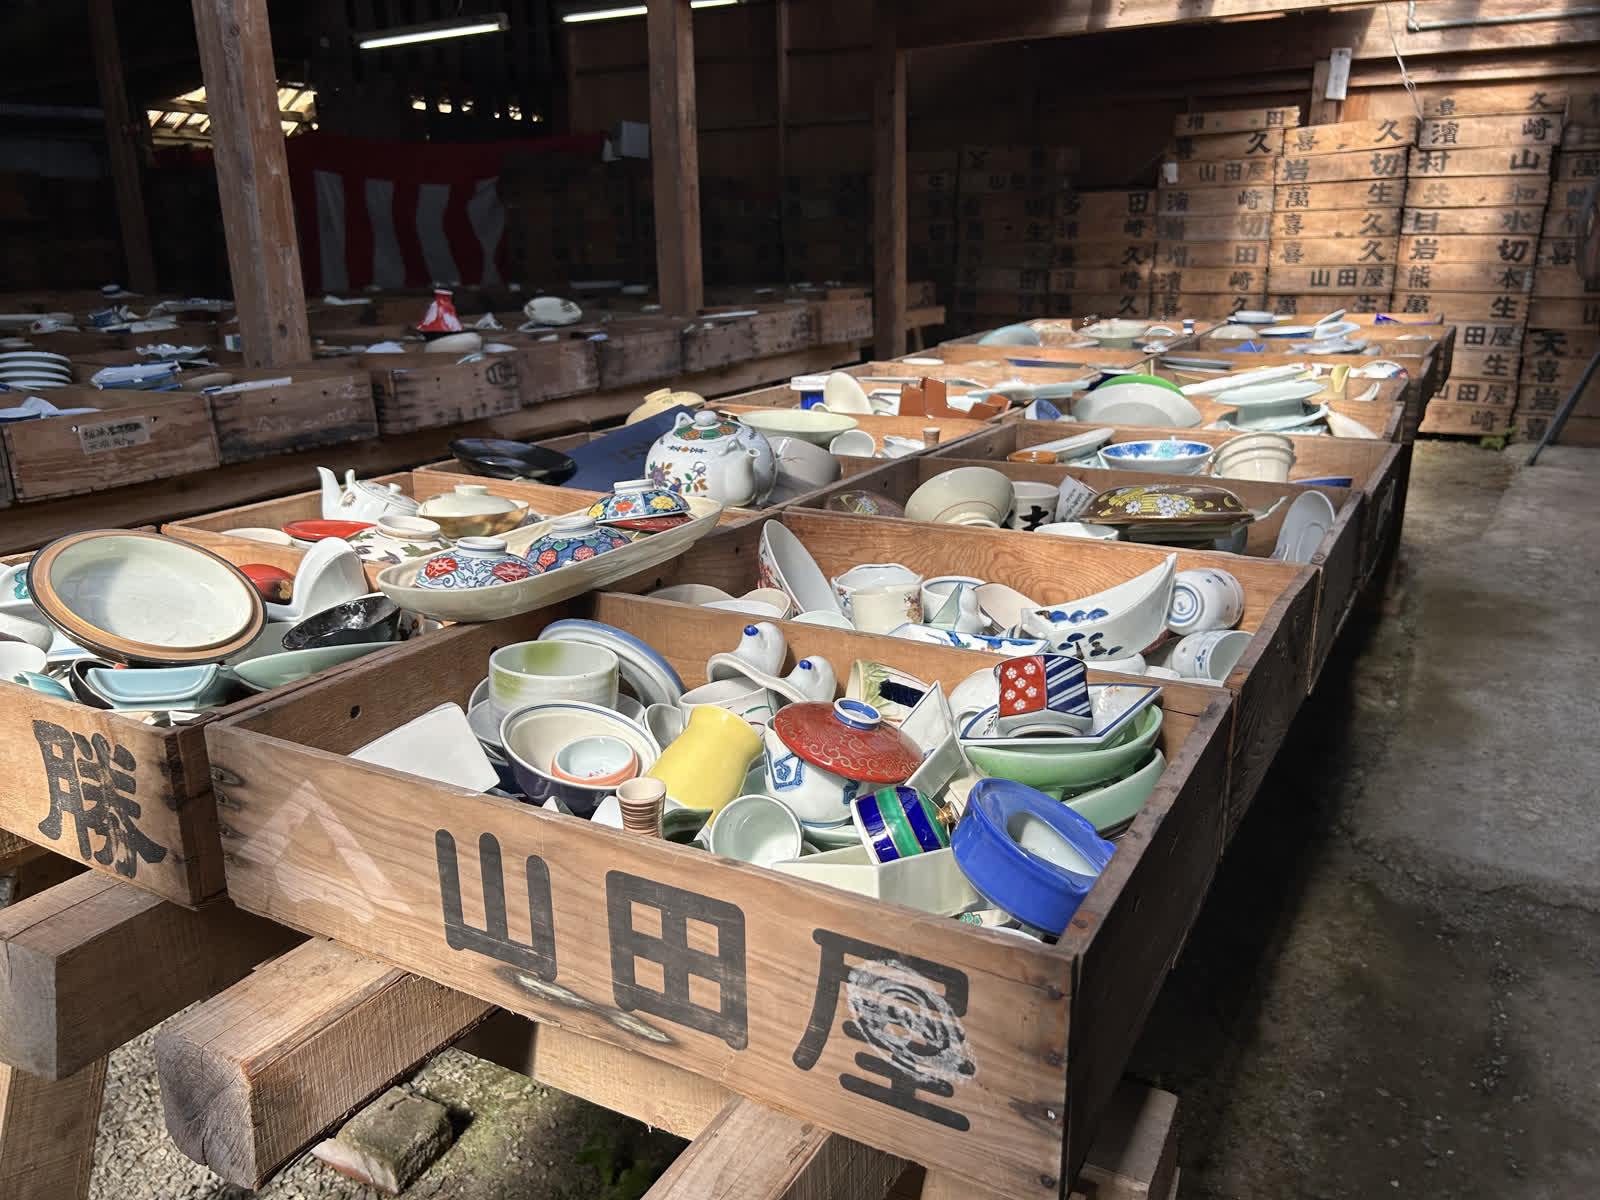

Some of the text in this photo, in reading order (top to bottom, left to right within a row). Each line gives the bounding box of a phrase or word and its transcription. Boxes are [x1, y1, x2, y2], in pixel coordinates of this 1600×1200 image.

[1293, 119, 1403, 151] 喜久
[1199, 161, 1266, 181] 山田屋
[1283, 153, 1400, 181] 岩切
[1416, 149, 1541, 174] 村山
[1280, 213, 1385, 236] 喜久
[1280, 240, 1386, 264] 喜久
[1409, 238, 1530, 262] 岩切
[1309, 268, 1385, 288] 山田屋
[33, 719, 167, 878] 勝
[435, 828, 977, 1131] 山田屋
